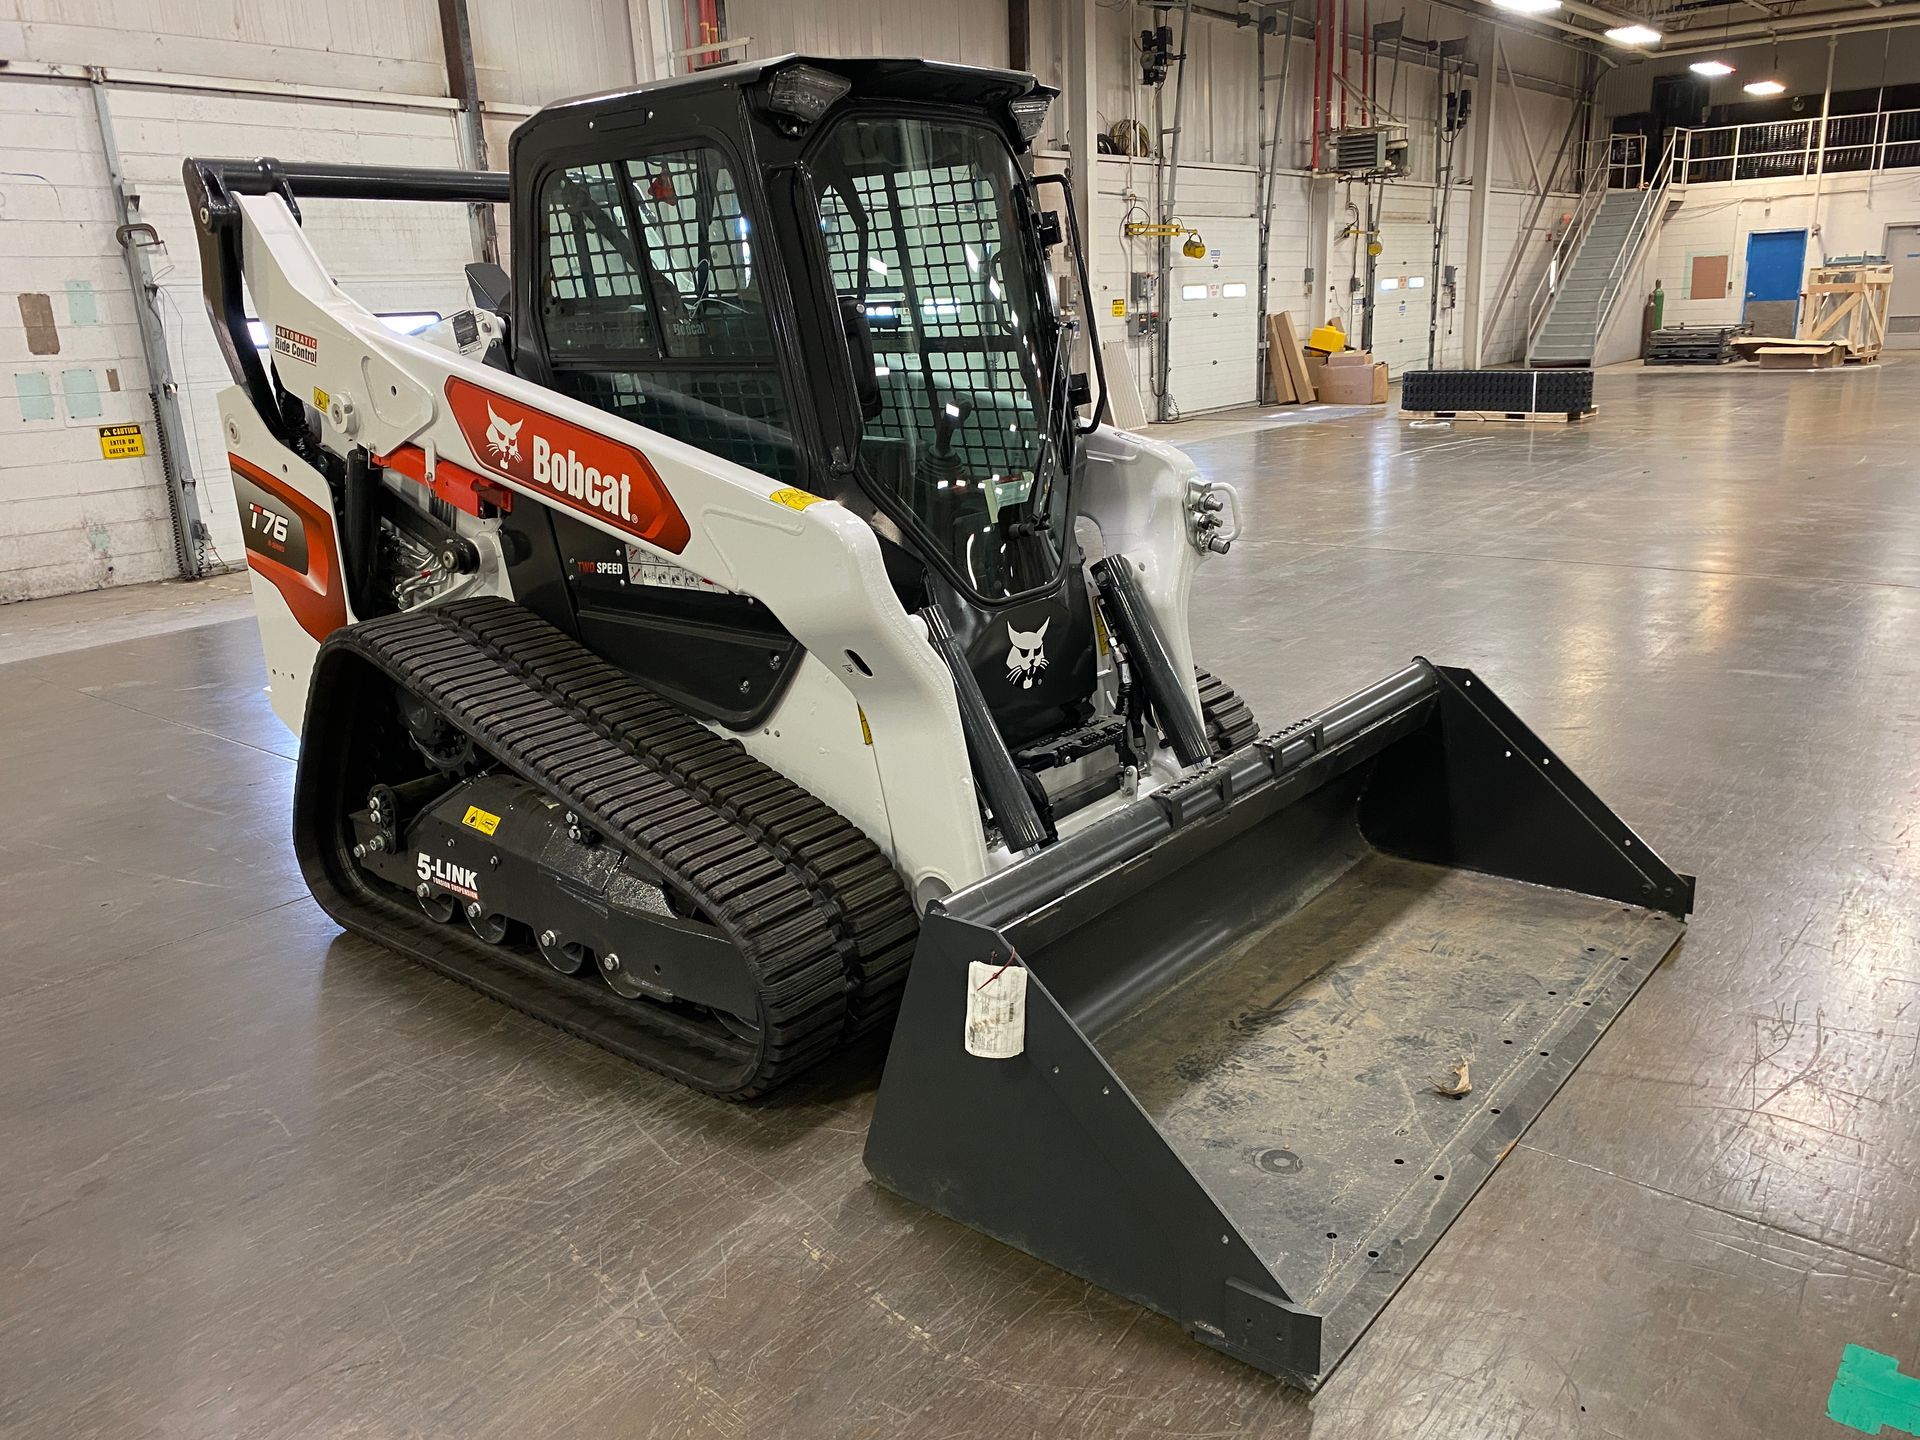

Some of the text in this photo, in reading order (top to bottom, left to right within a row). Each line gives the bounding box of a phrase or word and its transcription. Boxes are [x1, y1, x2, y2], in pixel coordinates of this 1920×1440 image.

[275, 337, 317, 363] Ride Control
[276, 326, 317, 348] AUTOMATIC
[112, 426, 138, 436] CAUTION
[533, 434, 631, 522] Bobcat
[249, 502, 289, 543] T76
[577, 561, 623, 575] TWO SPEED
[416, 852, 478, 891] 5-LINK
